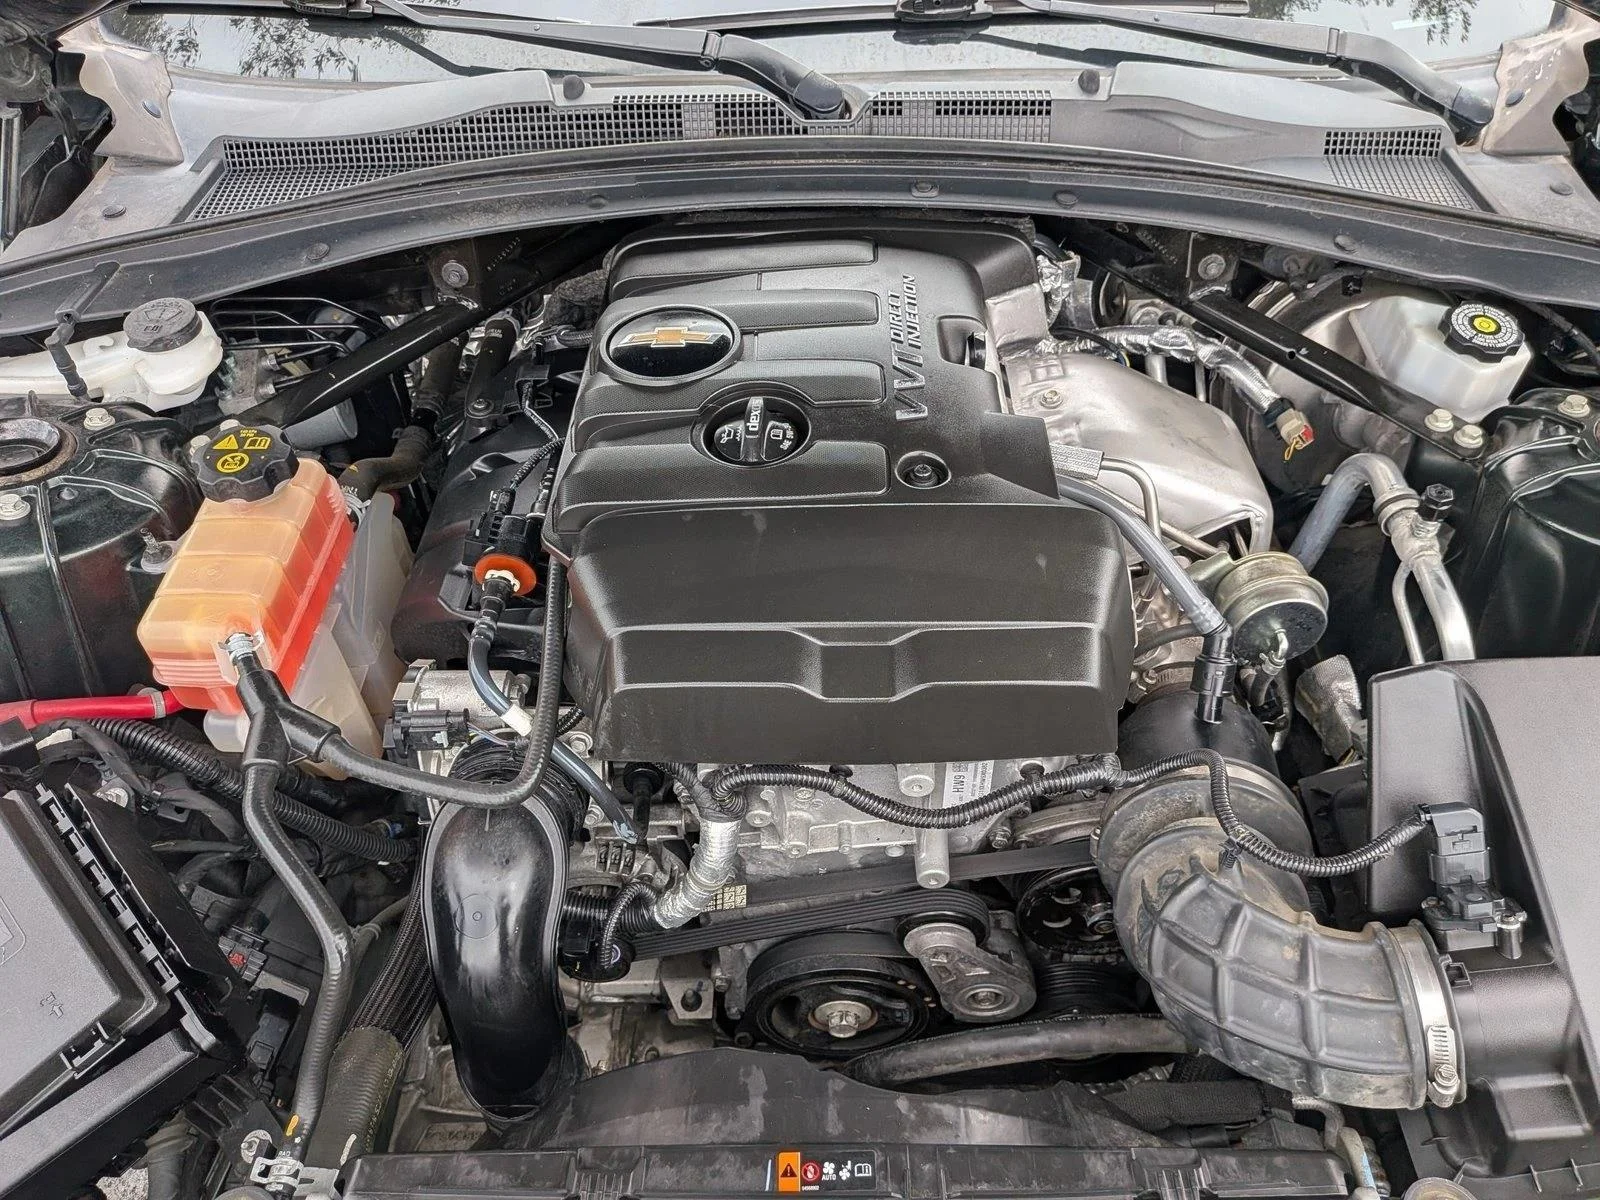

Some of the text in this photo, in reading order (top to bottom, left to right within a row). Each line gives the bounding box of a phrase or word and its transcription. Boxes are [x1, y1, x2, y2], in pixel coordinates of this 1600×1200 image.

[889, 290, 904, 343] DIRECT
[903, 274, 922, 348] INJECTION
[892, 342, 928, 420] VVT
[780, 438, 793, 451] SAE
[952, 775, 965, 792] HW9
